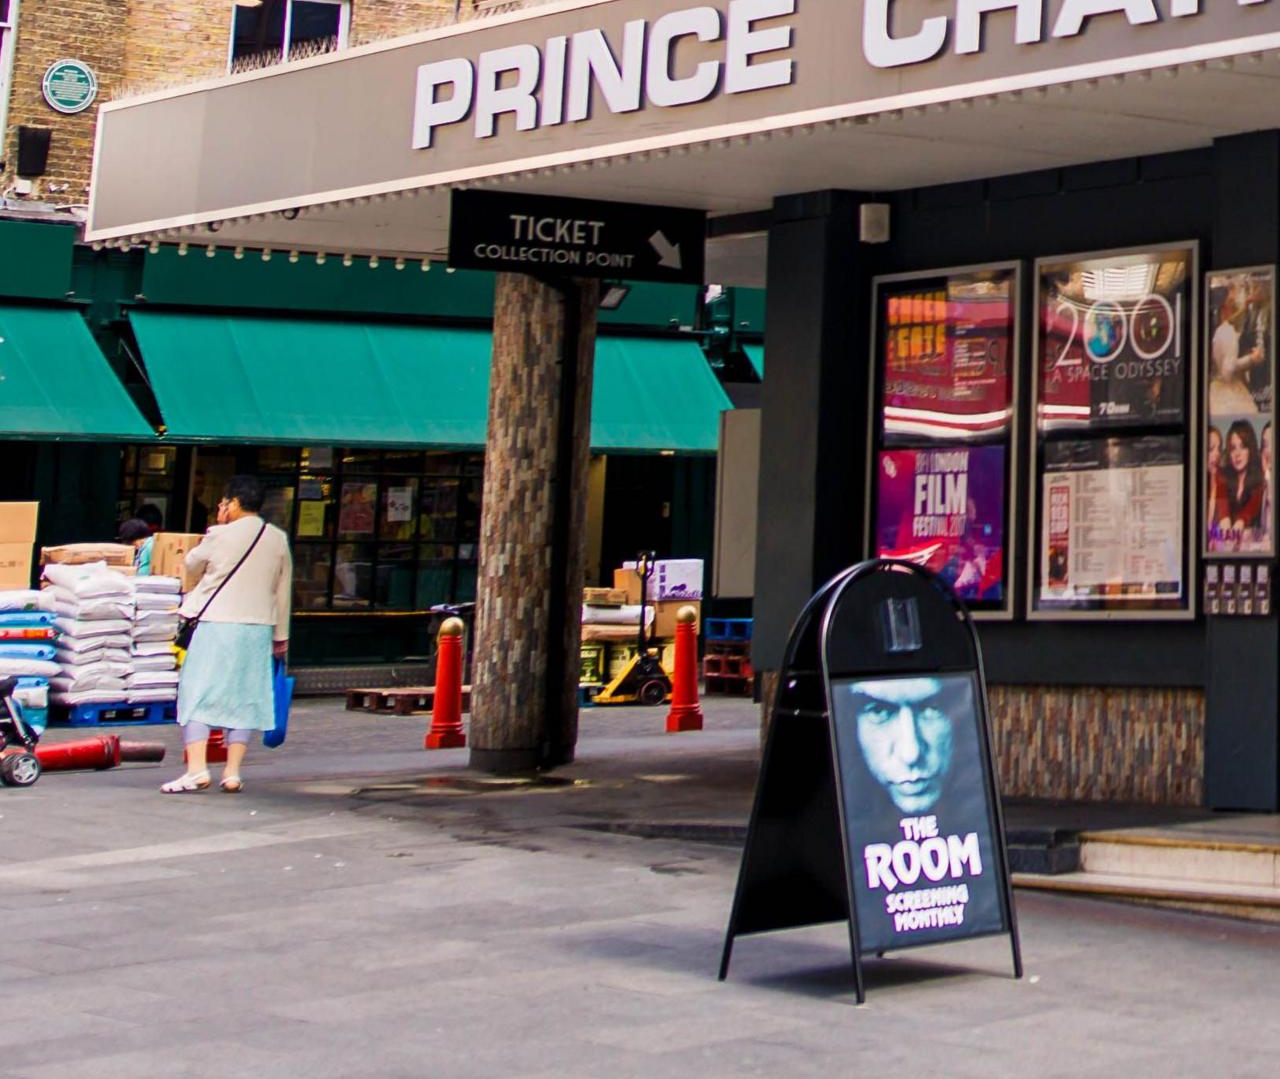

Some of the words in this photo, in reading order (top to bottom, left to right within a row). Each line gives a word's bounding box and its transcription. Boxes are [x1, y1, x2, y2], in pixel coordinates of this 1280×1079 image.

[510, 214, 605, 246] TICKET
[474, 243, 580, 265] COLLECTION
[586, 252, 635, 268] POINT
[1055, 293, 1182, 366] 2001
[1051, 368, 1063, 384] A
[1067, 363, 1109, 383] SPACE
[1115, 359, 1182, 380] ODYSSEY
[914, 473, 968, 516] FILM
[899, 815, 939, 841] THE
[863, 832, 983, 892] ROOM
[885, 883, 969, 914] SCREENING
[893, 905, 965, 932] MONTHLY
